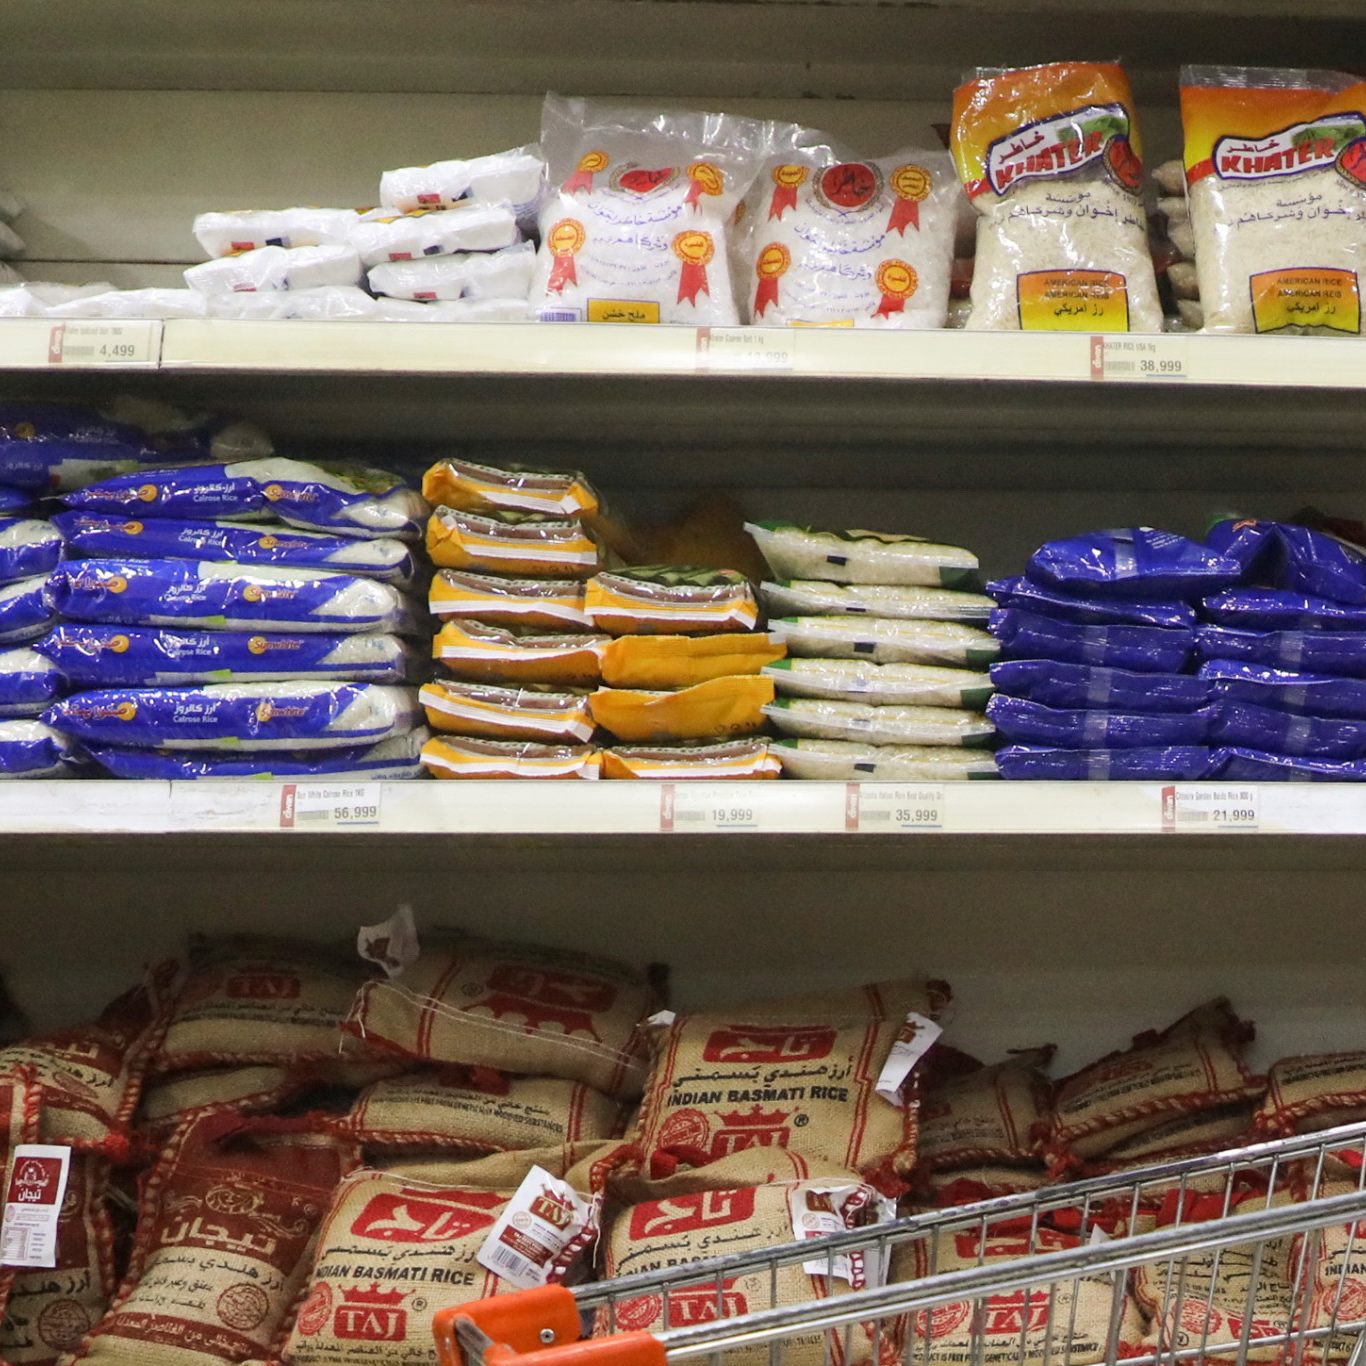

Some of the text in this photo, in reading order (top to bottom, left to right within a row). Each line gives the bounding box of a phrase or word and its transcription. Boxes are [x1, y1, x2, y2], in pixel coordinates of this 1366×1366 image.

[995, 131, 1104, 188] KHATER
[1221, 138, 1335, 174] KHATER
[99, 344, 136, 359] 4,499
[1140, 360, 1182, 374] 38,999
[193, 494, 237, 502] Calrose Rice
[195, 647, 212, 656] Rice
[253, 638, 304, 651] Sunwhite
[173, 715, 218, 724] Calrose Rice
[333, 805, 378, 819] 56,999
[712, 808, 753, 822] 19,999
[895, 808, 938, 822] 35,999
[1212, 808, 1255, 822] 21,999
[666, 1085, 849, 1107] INDIAN BASMATI RICE
[644, 1188, 738, 1234] تاج
[363, 1203, 472, 1241] تاج
[160, 1214, 278, 1256] تيجان
[352, 1264, 429, 1283] BASMATI
[430, 1267, 477, 1287] RICE
[679, 1297, 740, 1322] TAJ
[339, 1308, 400, 1339] TAJ
[986, 1307, 1048, 1331] TAJ
